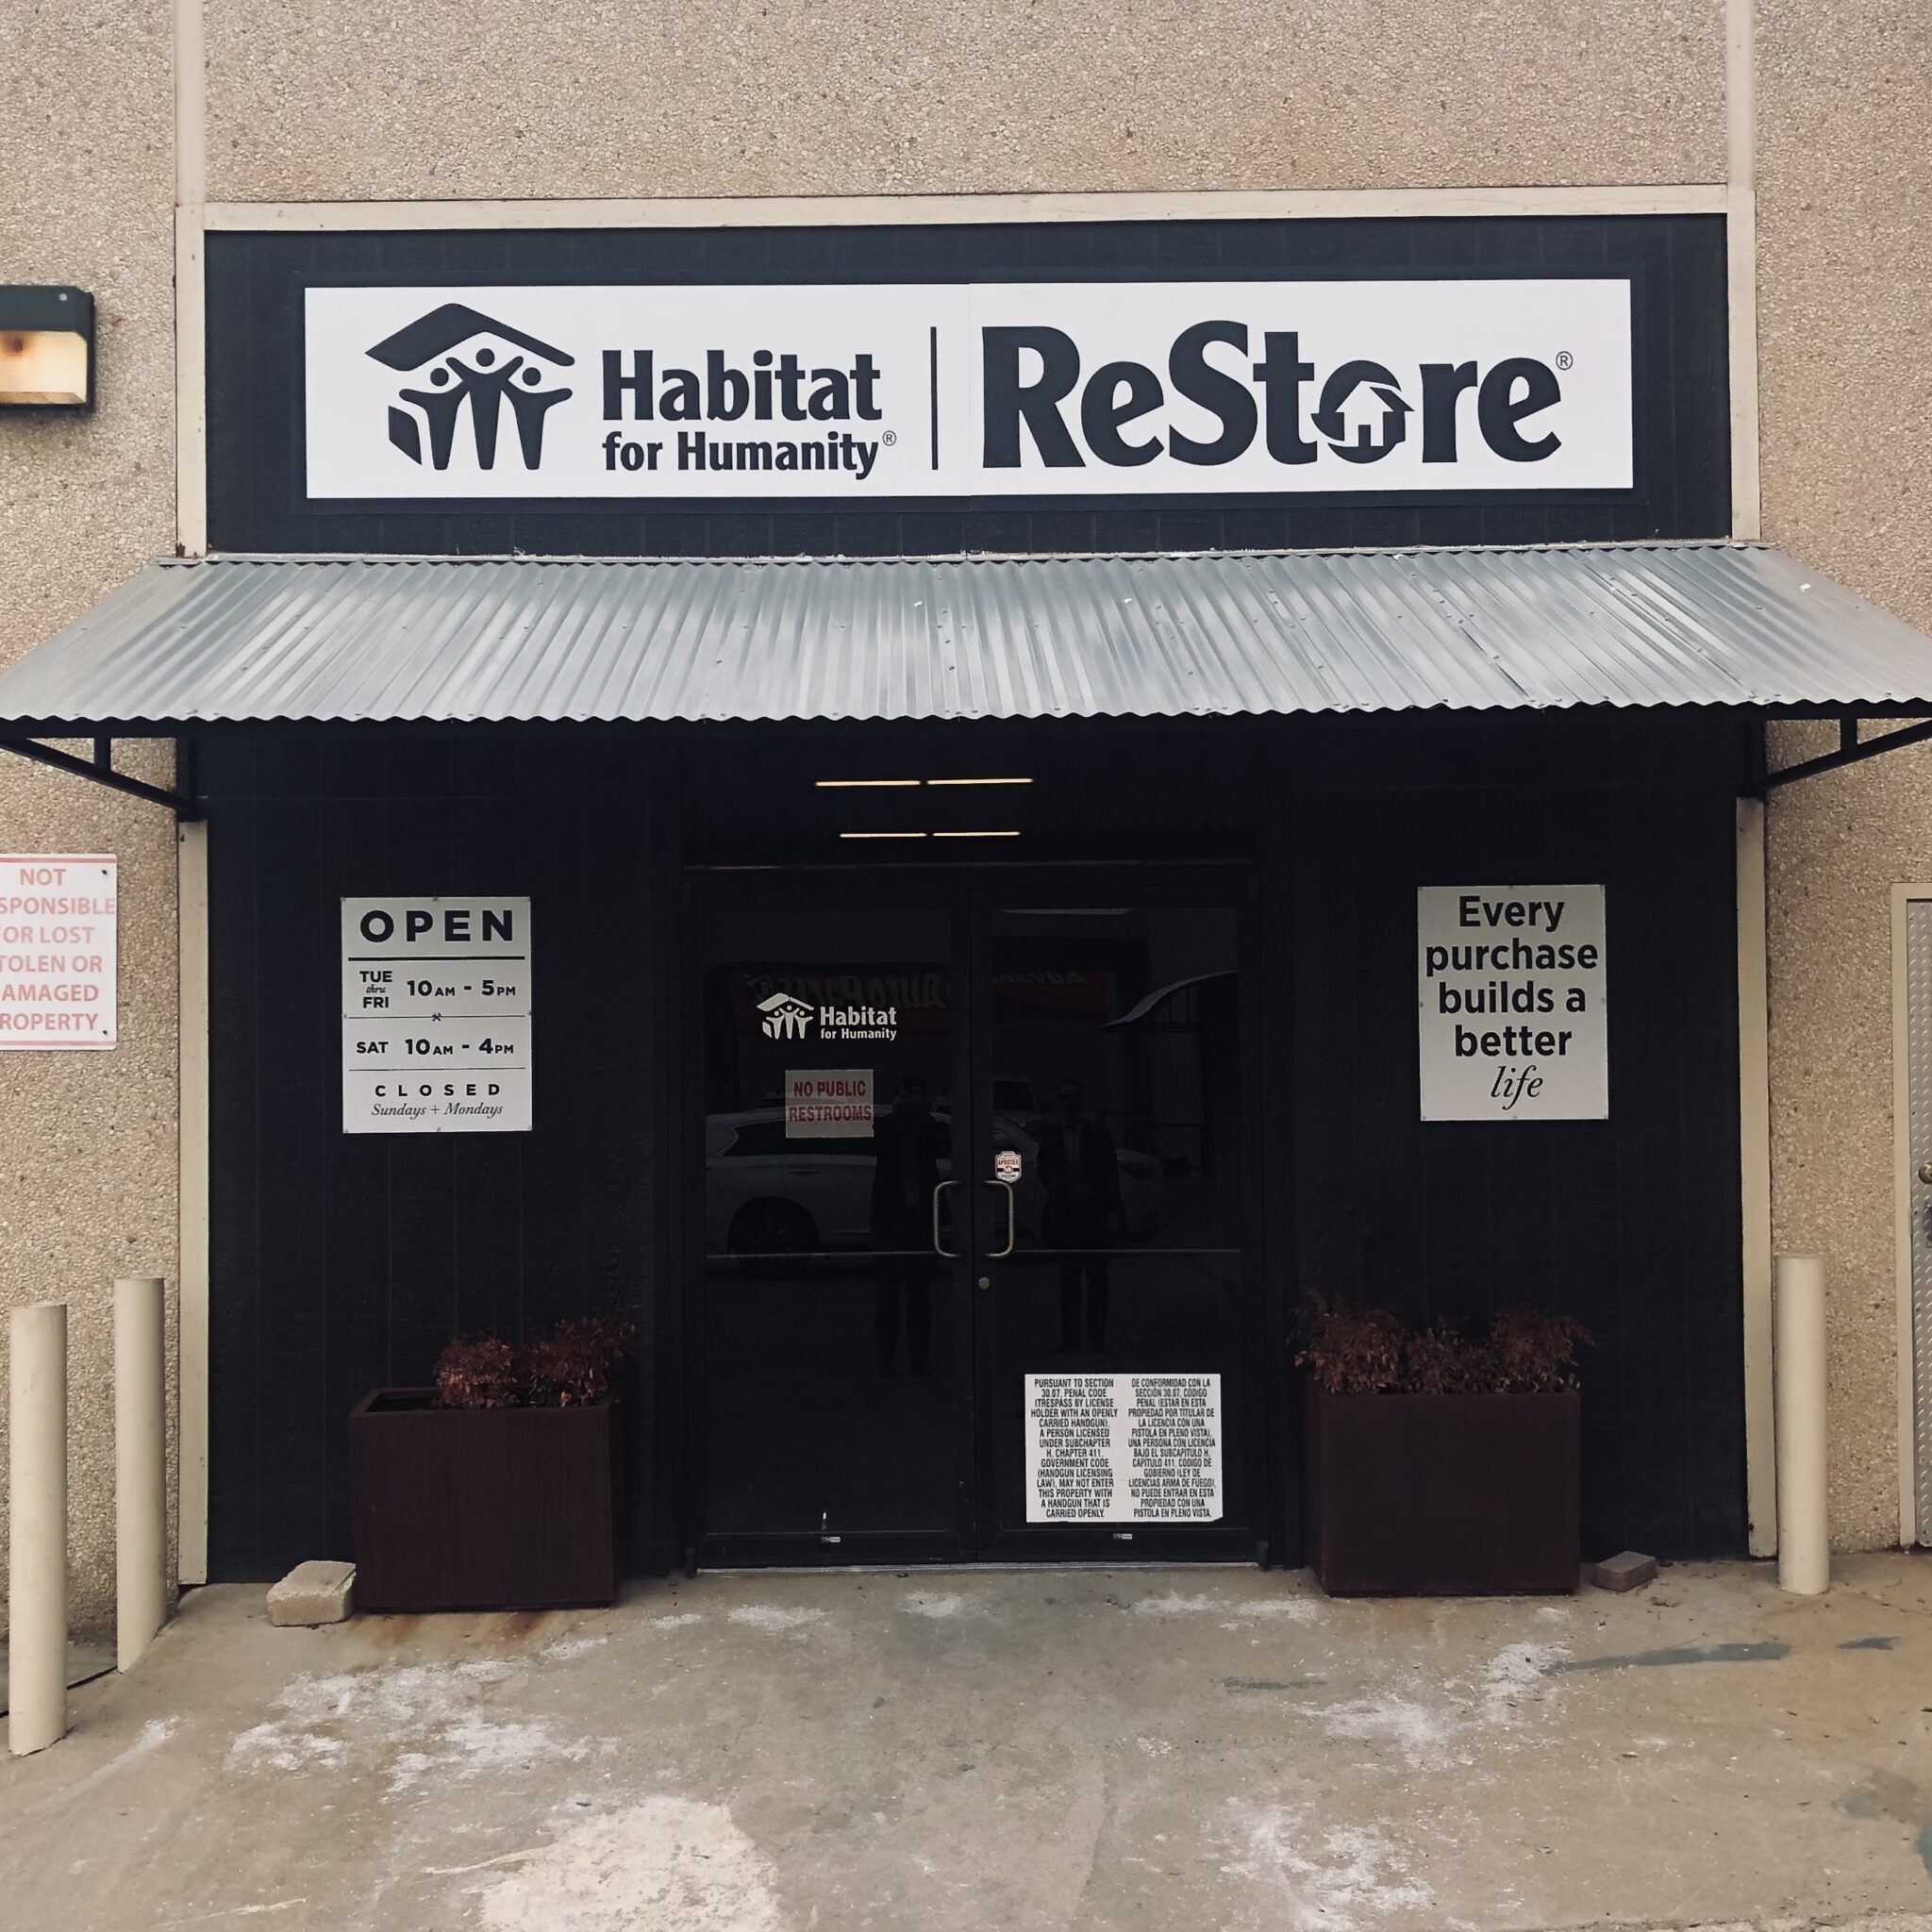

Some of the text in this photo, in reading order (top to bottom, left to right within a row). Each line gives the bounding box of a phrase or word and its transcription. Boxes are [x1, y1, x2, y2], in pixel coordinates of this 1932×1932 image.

[602, 350, 882, 421] Habitat
[603, 431, 662, 471] for
[20, 868, 66, 885] NOT
[1458, 895, 1565, 933] Every
[359, 909, 512, 943] OPEN
[40, 926, 94, 943] LOST
[1425, 938, 1598, 977] purchase
[72, 956, 103, 973] OR
[359, 971, 392, 983] TUE
[365, 984, 386, 993] thru
[1439, 980, 1586, 1014] builds a
[362, 997, 390, 1008] FRI
[820, 1006, 896, 1025] Habitat
[821, 1027, 896, 1041] for Humanity
[1455, 1024, 1572, 1057] better
[356, 1041, 389, 1054] SAT
[375, 1084, 500, 1097] CLOSED
[793, 1080, 866, 1096] NO PUBLIC
[1491, 1065, 1543, 1110] life
[371, 1103, 427, 1120] Sundays
[443, 1102, 504, 1120] Mondays
[789, 1106, 872, 1122] RESTROOMS
[1034, 1378, 1114, 1388] PURSUANT TO SECTION
[1131, 1378, 1210, 1387] DE CONFORMIDAD CON LA
[1064, 1389, 1086, 1398] PENAL
[1088, 1389, 1107, 1398] CODE
[1035, 1398, 1114, 1407] (TRESPASS BY LICENSE
[1137, 1398, 1156, 1407] PENAL
[1181, 1398, 1190, 1407] EN
[1191, 1398, 1207, 1407] ESTA
[1031, 1408, 1118, 1417] HOLDER WITH AN OPENLY
[1128, 1408, 1214, 1417] PROPIEDAD POR TITULAR DE
[1039, 1418, 1069, 1427] CARRIED
[1040, 1428, 1109, 1437] A PERSON LICENSED
[1131, 1428, 1157, 1437] PISTOLA
[1158, 1428, 1167, 1437] EN
[1169, 1428, 1189, 1437] PLENO
[1039, 1439, 1110, 1447] UNDER SUBCHAPTER
[1128, 1438, 1215, 1447] UNA PERSONA CON LICENCIA
[1056, 1449, 1087, 1457] CHAPTER
[1134, 1448, 1149, 1457] BAJO
[1151, 1448, 1158, 1457] EL
[1041, 1458, 1108, 1467] GOVERNMENT CODE
[1204, 1458, 1211, 1468] DE
[1038, 1469, 1112, 1478] (HANDGUN LICENSING
[1144, 1469, 1175, 1477] GOBIERNO
[1192, 1469, 1201, 1477] DE
[1059, 1478, 1074, 1488] MAY
[1075, 1478, 1089, 1488] NOT
[1091, 1478, 1114, 1488] ENTER
[1128, 1478, 1160, 1488] LICENCIAS
[1162, 1478, 1180, 1488] ARMA
[1182, 1478, 1191, 1488] DE
[1039, 1489, 1112, 1498] THIS PROPERTY WITH
[1131, 1489, 1214, 1497] NO PUEDE ENTRAR EN ESTA
[1041, 1499, 1109, 1507] A HANDGUN THAT IS
[1141, 1499, 1205, 1507] PROPIEDAD CON UNA
[1046, 1508, 1075, 1518] CARRIED
[1134, 1508, 1159, 1517] PISTOLA
[1161, 1508, 1169, 1517] EN
[1171, 1508, 1191, 1517] PLENO
